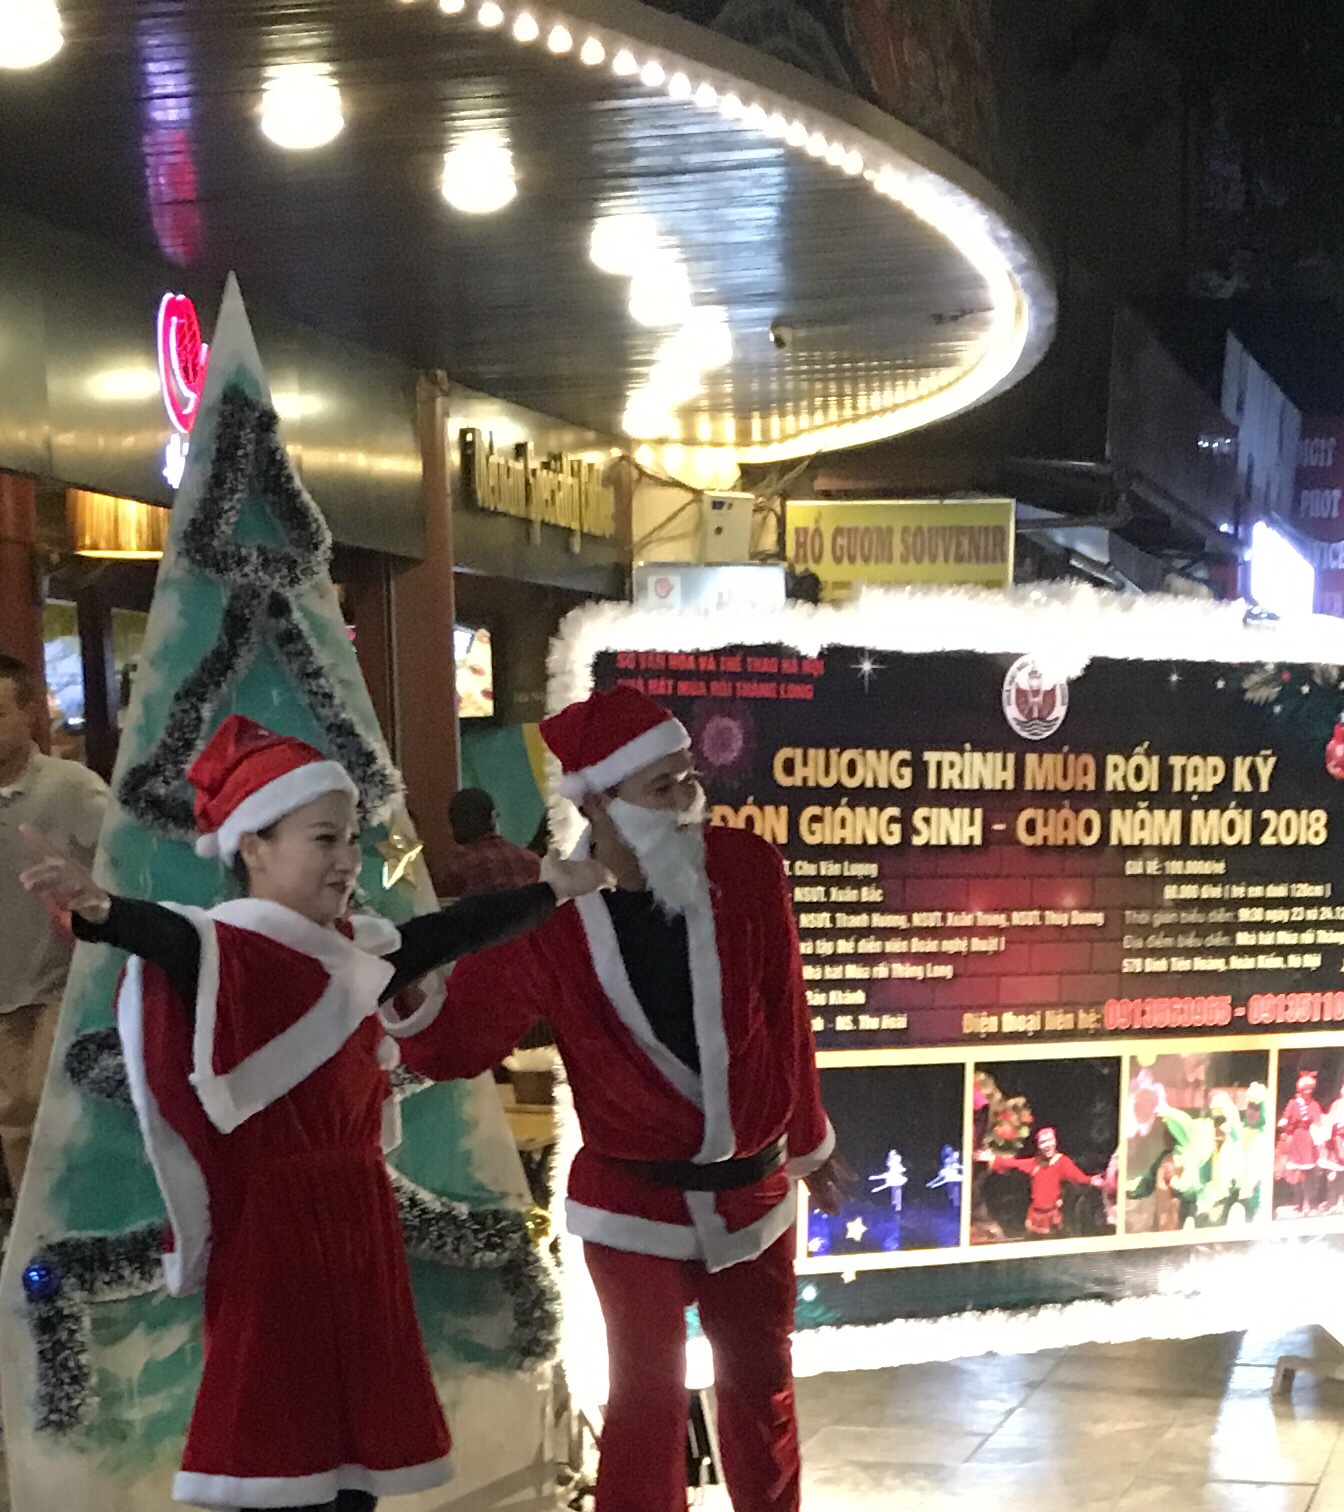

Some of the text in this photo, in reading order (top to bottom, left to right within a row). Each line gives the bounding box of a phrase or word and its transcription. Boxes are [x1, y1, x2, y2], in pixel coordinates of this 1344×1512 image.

[900, 524, 1007, 565] SOUVENIR
[923, 743, 1016, 790] TRÌNH
[1023, 745, 1096, 791] MÚA
[1106, 741, 1160, 792] RỐI
[1168, 754, 1227, 801] TẠP
[1232, 749, 1278, 793] KỸ
[798, 797, 902, 846] GIÁNG
[911, 806, 983, 846] SINH
[1015, 799, 1102, 847] CHÀO
[1109, 800, 1182, 847] NĂM
[1189, 800, 1253, 847] MỚI
[1259, 808, 1329, 847] 2018
